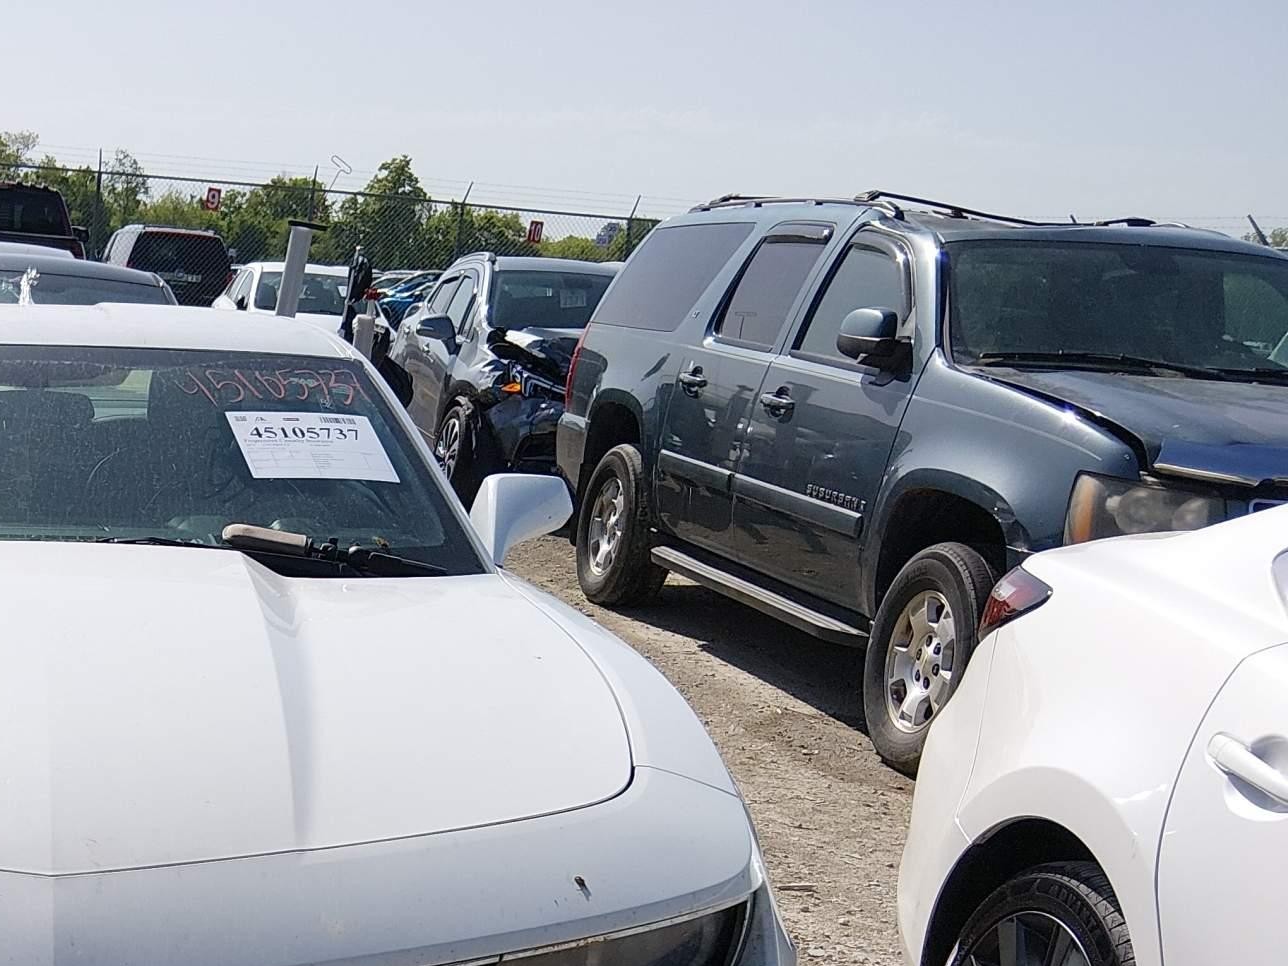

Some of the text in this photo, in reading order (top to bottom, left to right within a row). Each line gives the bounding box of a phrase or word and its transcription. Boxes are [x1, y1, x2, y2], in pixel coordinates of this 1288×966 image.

[208, 189, 219, 209] 9
[530, 223, 542, 241] 10
[249, 426, 359, 441] 45105737
